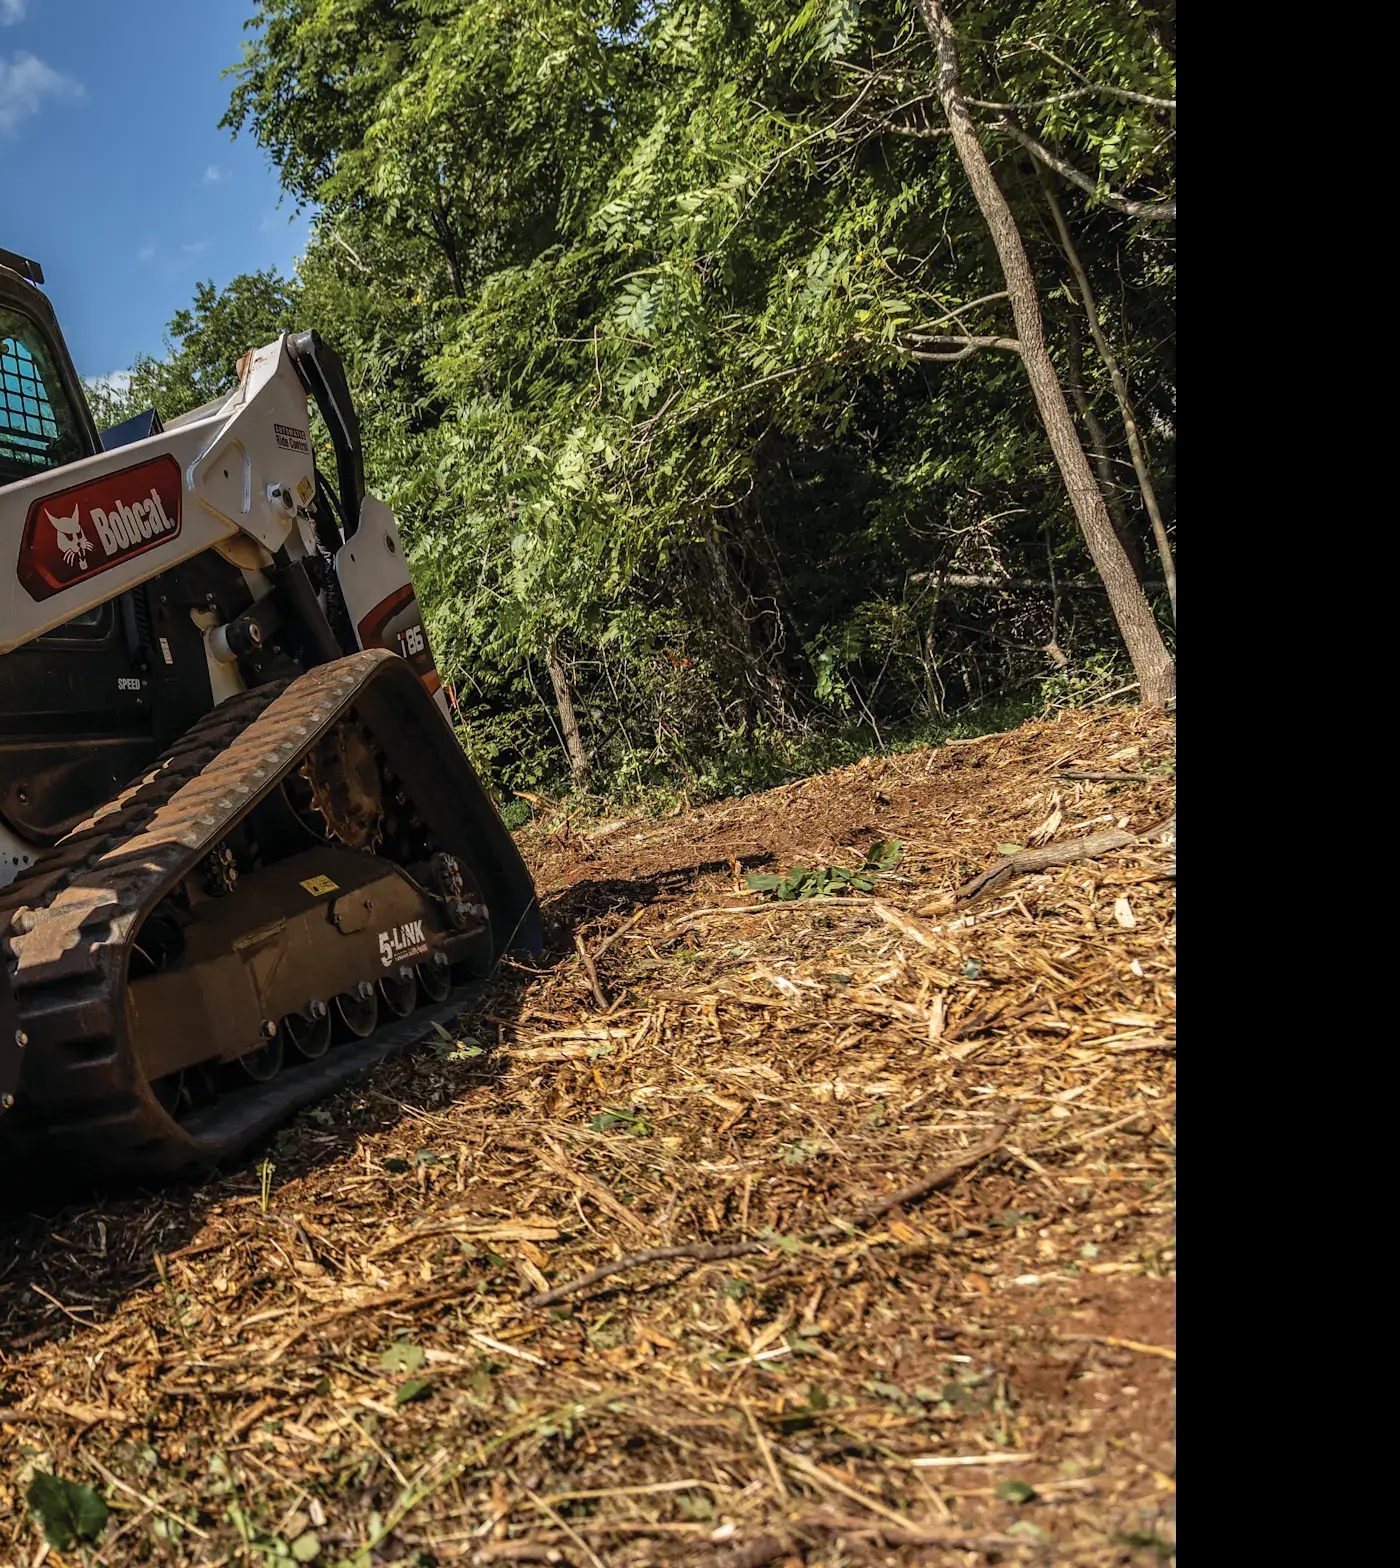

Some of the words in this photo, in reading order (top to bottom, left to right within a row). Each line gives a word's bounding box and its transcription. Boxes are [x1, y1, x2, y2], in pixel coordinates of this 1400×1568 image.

[276, 434, 290, 447] Ride
[290, 437, 309, 451] Control
[90, 488, 172, 556] Bobcat
[117, 677, 141, 690] SPEED
[378, 919, 426, 967] 5-LINK
